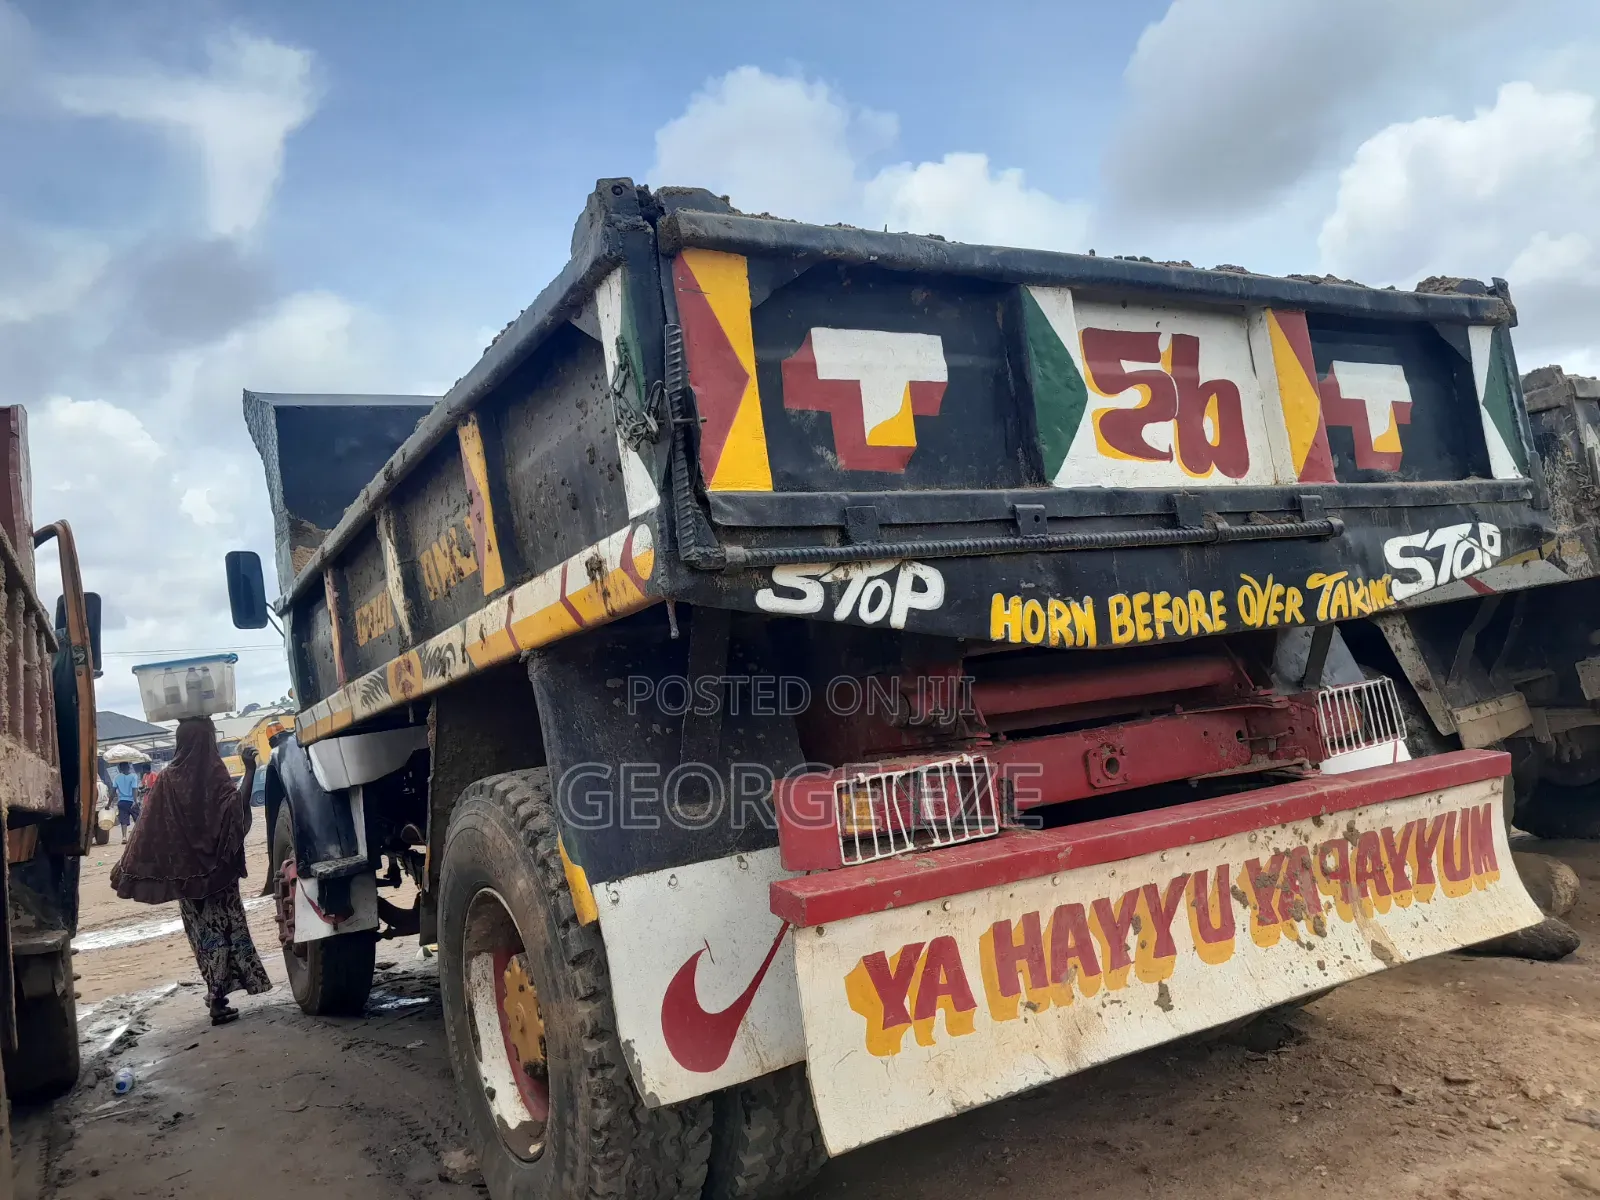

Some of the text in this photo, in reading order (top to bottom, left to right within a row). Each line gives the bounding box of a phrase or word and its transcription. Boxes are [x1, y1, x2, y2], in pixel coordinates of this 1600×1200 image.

[809, 326, 948, 448] T
[1332, 360, 1413, 453] T
[755, 558, 946, 629] STOP
[1384, 521, 1501, 600] STOP
[990, 592, 1097, 648] HORN
[1108, 590, 1227, 644] BEFORE
[1238, 573, 1305, 628] OVER
[858, 934, 979, 1035] YA
[988, 863, 1236, 1005] HAYYU
[1243, 845, 1324, 930] YA
